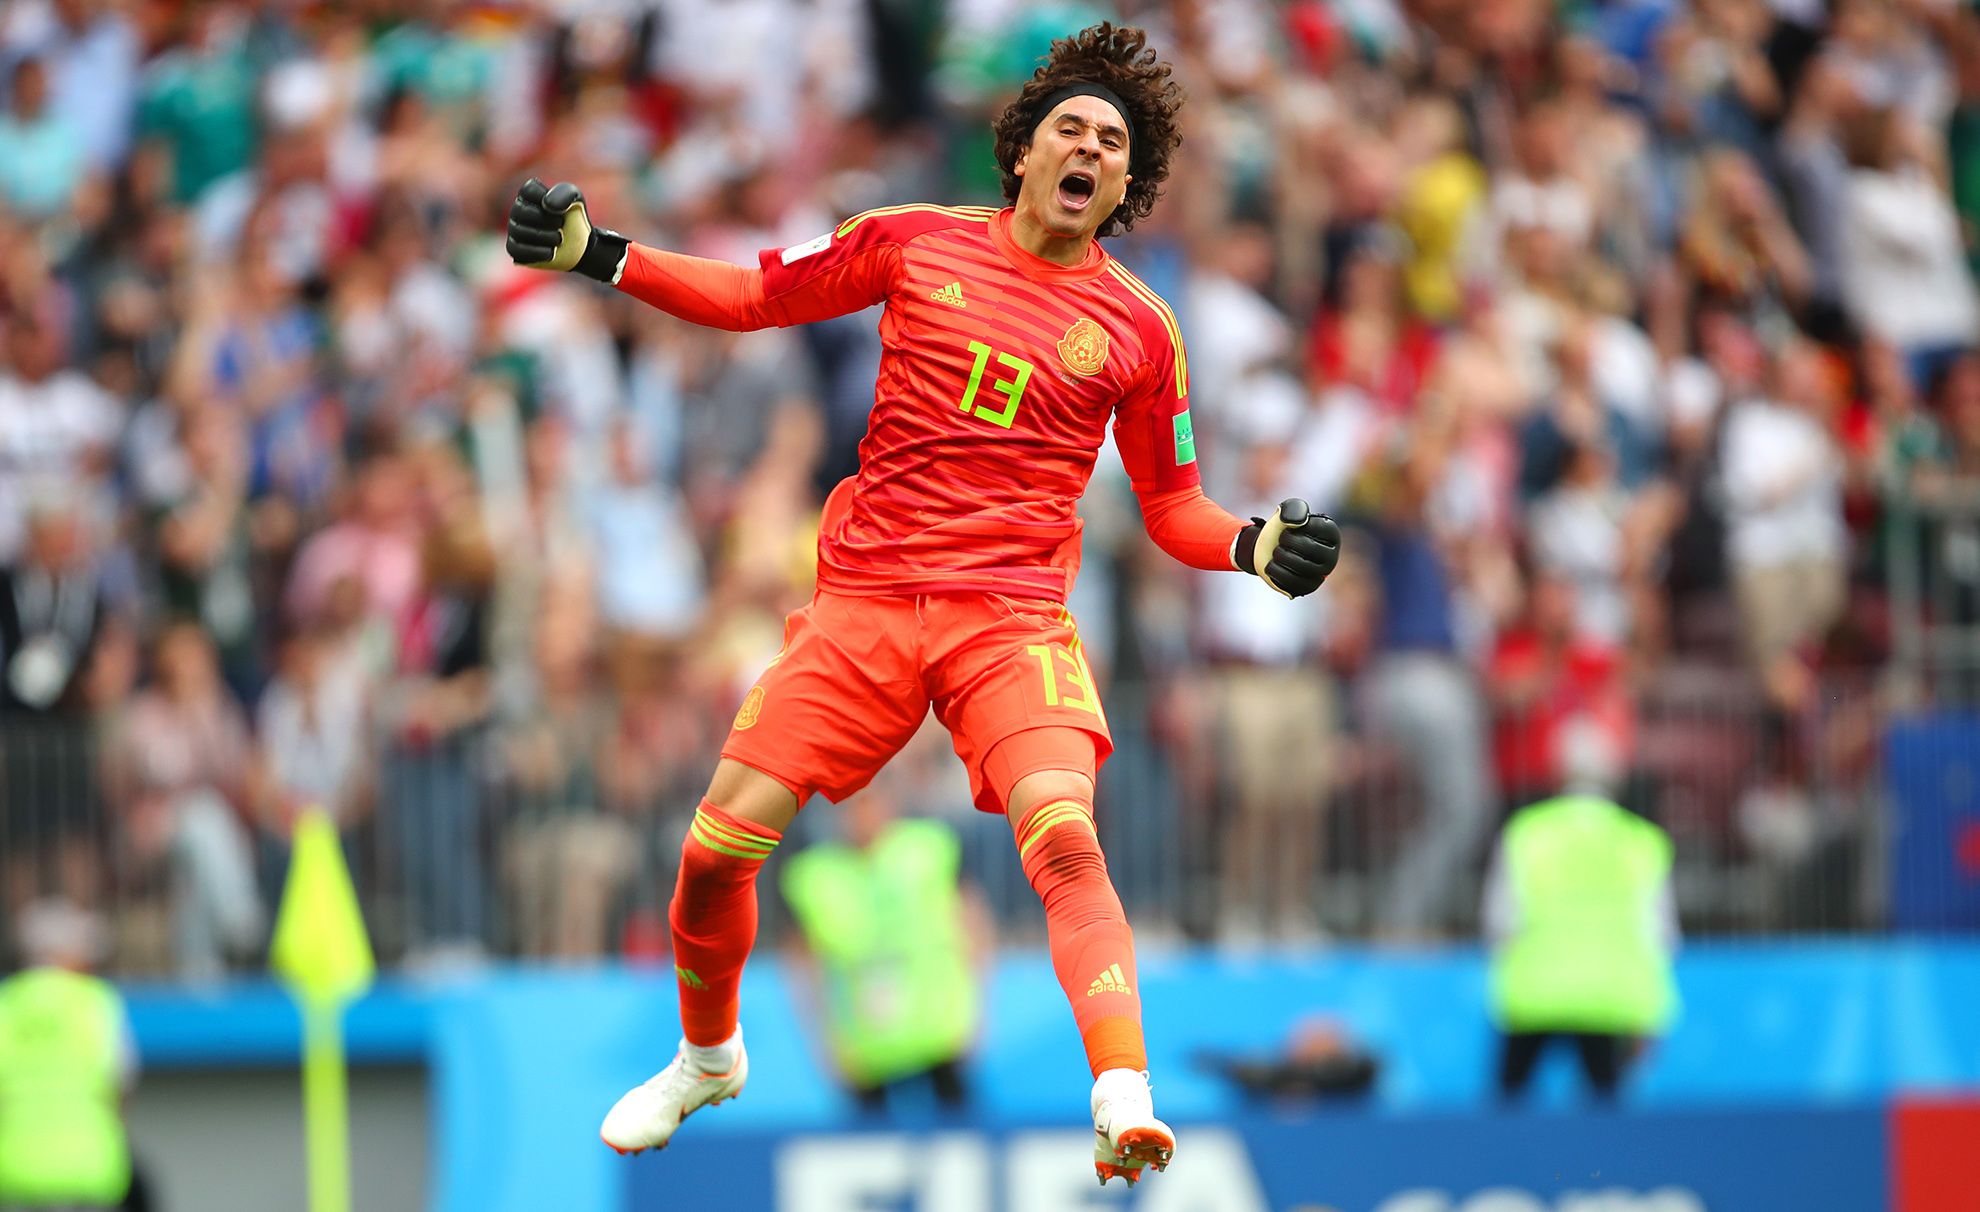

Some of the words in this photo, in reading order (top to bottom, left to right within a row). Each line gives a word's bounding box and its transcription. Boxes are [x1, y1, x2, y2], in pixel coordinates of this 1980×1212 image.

[930, 292, 967, 308] adidas
[958, 340, 1034, 429] 13
[1026, 645, 1097, 715] 13
[1087, 983, 1132, 997] adidas
